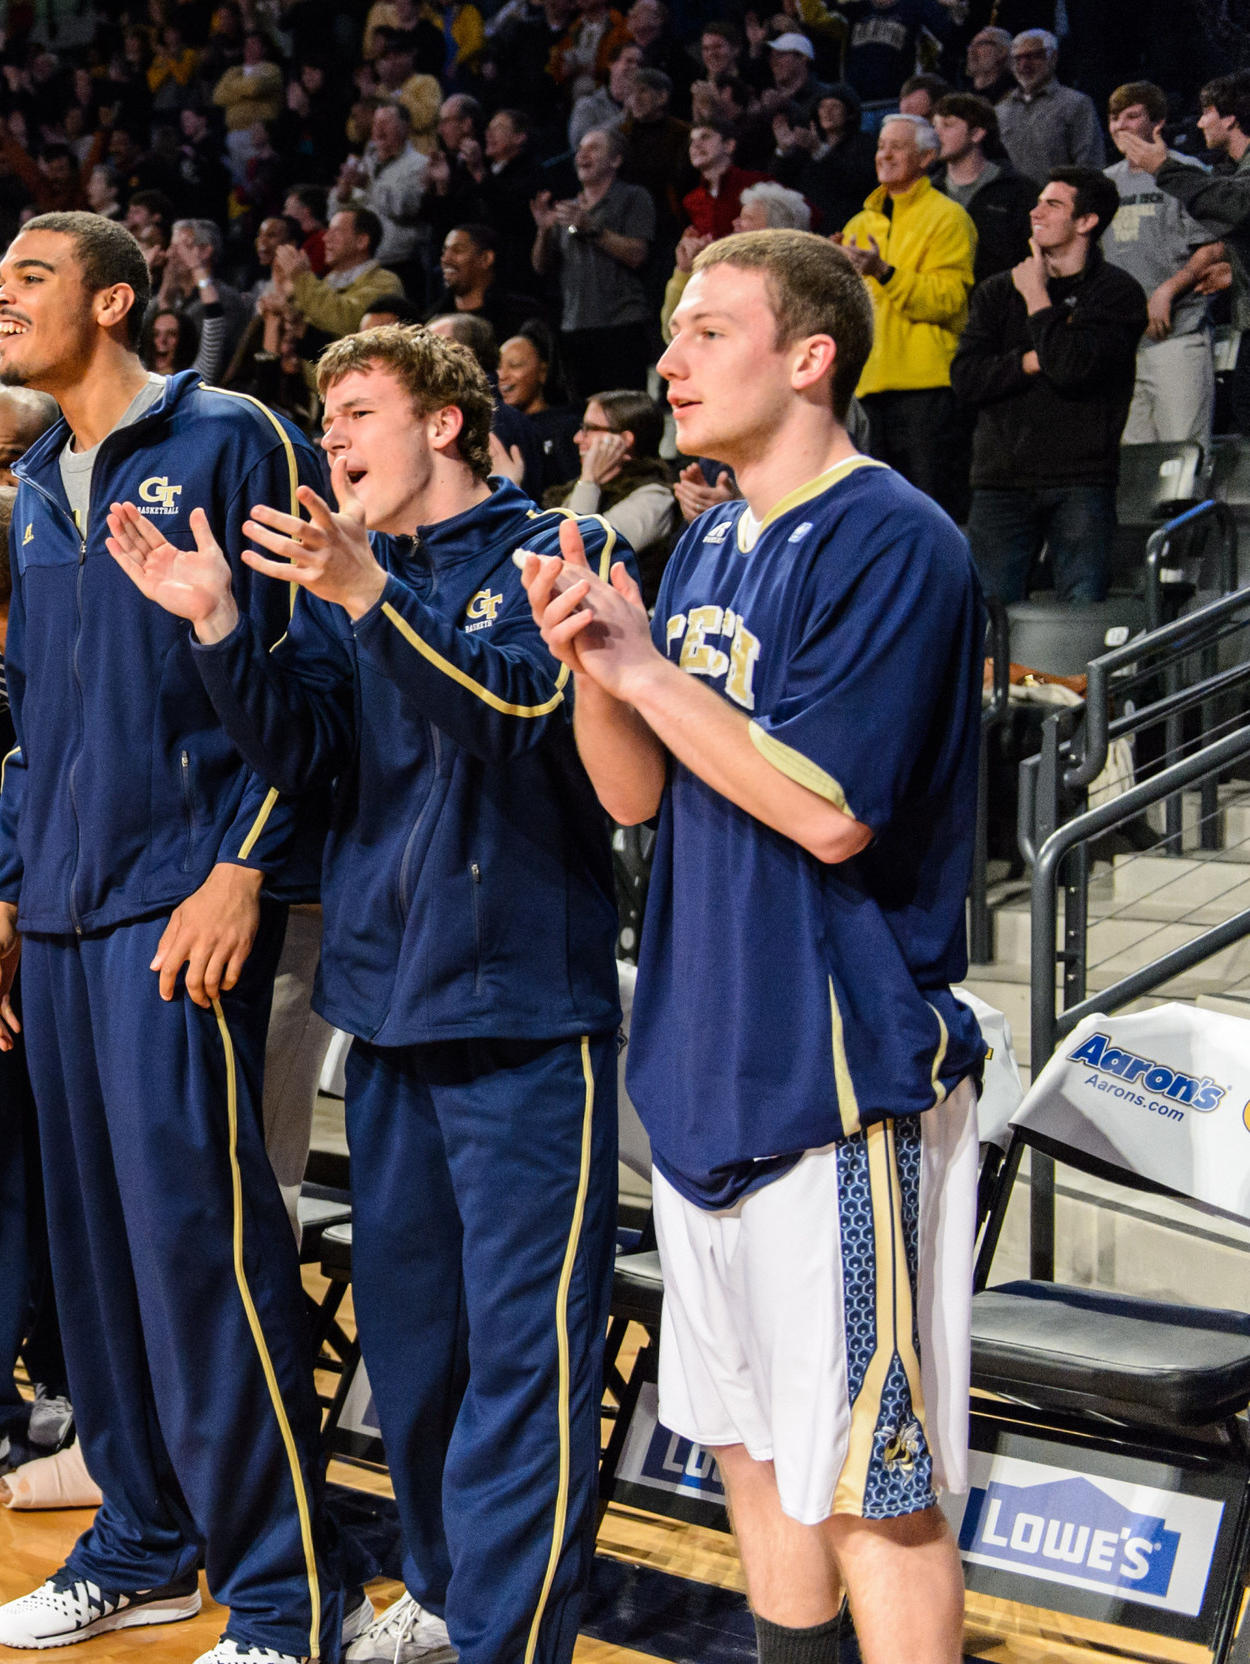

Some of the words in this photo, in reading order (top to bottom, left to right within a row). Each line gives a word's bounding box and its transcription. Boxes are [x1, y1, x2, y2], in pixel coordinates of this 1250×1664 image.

[138, 476, 182, 507] GT
[137, 506, 179, 515] BASKETBALL
[466, 588, 503, 620] GT
[465, 620, 493, 634] BASKETB
[1066, 1032, 1226, 1113] Aaron's
[1084, 1073, 1185, 1122] Aarons.com
[981, 1498, 1153, 1580] LOWE'S
